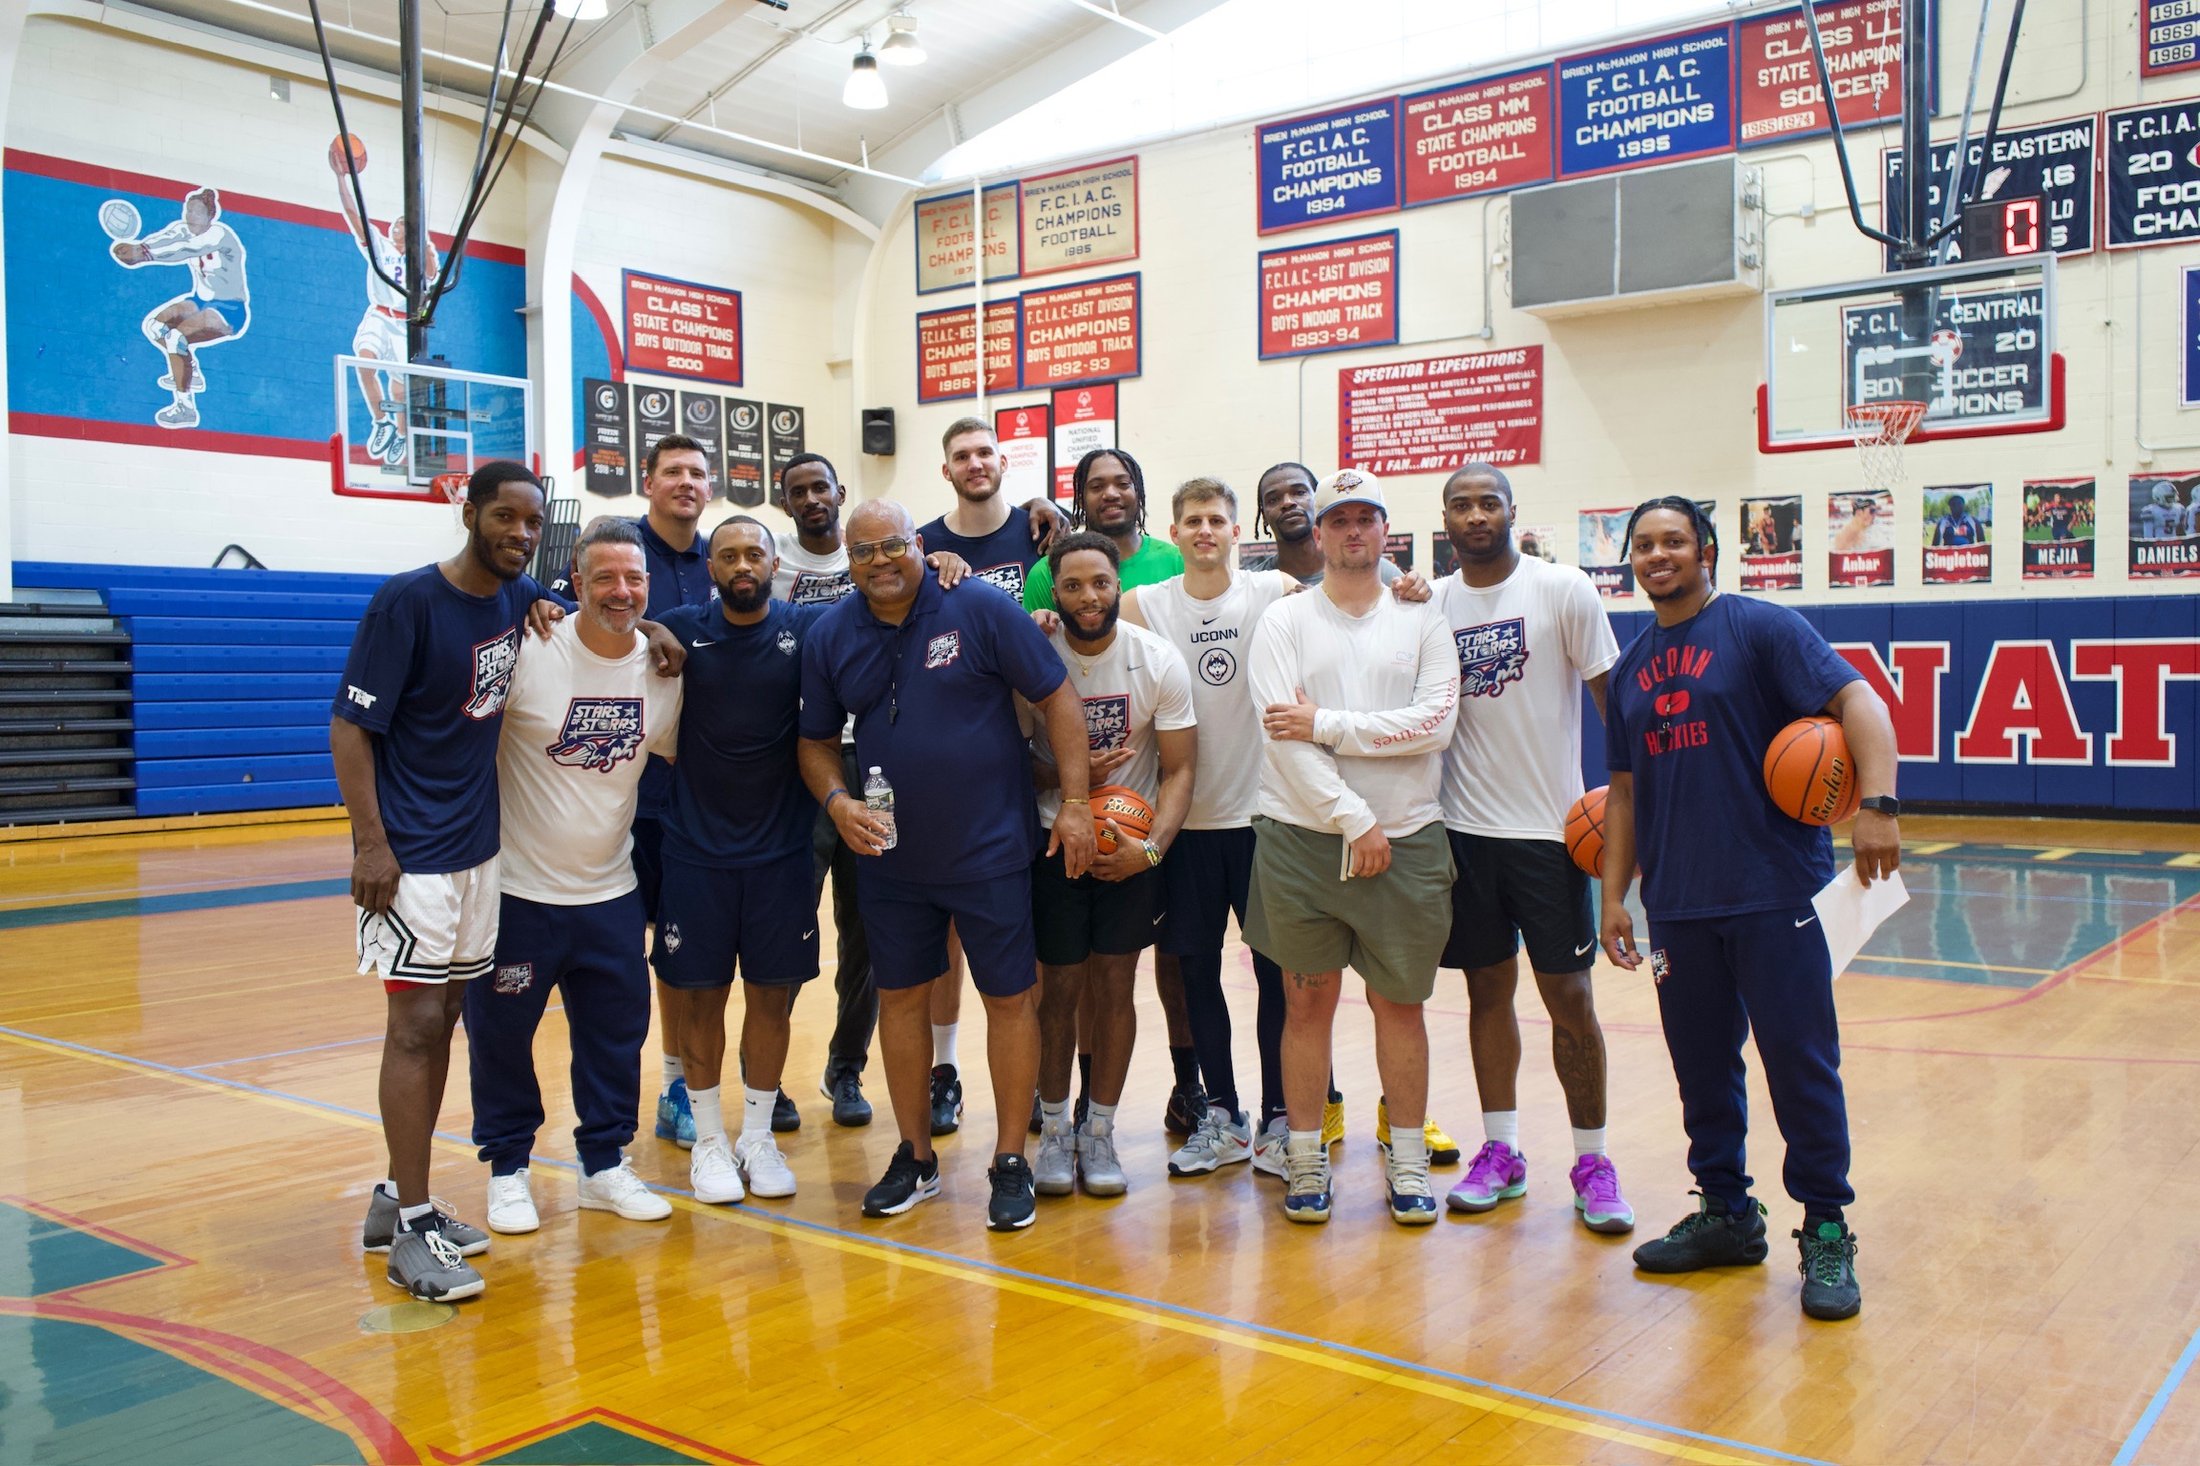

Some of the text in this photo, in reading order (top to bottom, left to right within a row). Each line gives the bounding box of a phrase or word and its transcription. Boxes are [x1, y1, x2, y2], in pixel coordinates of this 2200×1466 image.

[1840, 8, 1861, 20] HIGH
[2154, 1, 2193, 20] 1961
[1765, 26, 1853, 60] CLASS
[2154, 24, 2193, 42] 1969
[1562, 64, 1593, 79] BRIEN
[1652, 45, 1679, 60] HIGH
[1682, 37, 1728, 54] SCHOOL
[1758, 43, 1903, 87] STATE HAMPION
[2153, 45, 2192, 64] 1986
[1483, 85, 1505, 98] HIGH
[1508, 77, 1546, 93] SCHOOL
[1779, 71, 1890, 109] SOCCER
[1587, 82, 1701, 120] FOOTBALL
[1331, 117, 1352, 129] HIGH
[1354, 109, 1390, 124] SCHOOL
[1423, 95, 1530, 132] CLASS MM
[1576, 103, 1715, 146] CHAMPIONS
[1416, 116, 1537, 156] STATE CHAMPIONS
[1618, 134, 1671, 158] 1995
[1282, 149, 1371, 180] FOOTBALL
[1428, 142, 1527, 175] FOOTBALL
[2128, 150, 2173, 175] 20
[1102, 168, 1133, 181] SCHOOL
[1273, 167, 1382, 203] CHAMPIONS
[1455, 168, 1498, 189] 1994
[2042, 163, 2075, 189] 16
[1306, 195, 1346, 215] 1994
[1035, 203, 1121, 231] CHAMPIONS
[2006, 200, 2038, 254] 0
[2133, 208, 2200, 236] CHA
[936, 226, 997, 248] FOOTBLL
[1041, 224, 1116, 247] FOOTBALL
[928, 241, 1007, 268] CHAMPONS
[1358, 241, 1394, 255] SCHOOL
[1349, 256, 1390, 278] DIVISION
[1105, 282, 1135, 294] SCHOOL
[1272, 281, 1382, 310] CHAMPIONS
[647, 296, 702, 318] CLASS
[706, 294, 733, 306] SCHOOL
[1098, 295, 1133, 314] DIVISION
[633, 312, 734, 343] STATE CHAMPIONS
[1271, 303, 1383, 332] BOYS INDOOR TRACK
[1029, 316, 1130, 345] CHAMPIONS
[1291, 326, 1360, 347] 1993-94
[1995, 330, 2036, 353] 20
[634, 332, 733, 360] BOYS OUTDOOR TRACK
[925, 337, 1012, 361] CHAMPONS
[1026, 336, 1133, 363] BOYS OUTDOOR TRACK
[667, 356, 704, 372] 2000
[925, 354, 1012, 379] BOYS INDOO TRACK
[1352, 349, 1526, 383] SPECTATOR EXPECTATIONS
[939, 373, 997, 392] 1986-7
[1863, 377, 1903, 398] BOY
[1373, 460, 1381, 472] A
[1448, 454, 1457, 465] A
[1462, 449, 1516, 464] FANATIC
[1842, 556, 1880, 573] Anbar
[1925, 550, 1989, 572] Singleton
[2037, 547, 2079, 566] MEJIA
[2137, 544, 2199, 566] DANIELS
[1591, 571, 1623, 587] Anbar
[1740, 559, 1803, 577] Hernandez
[799, 575, 842, 587] STARS
[1190, 627, 1239, 644] UCONN
[1457, 628, 1501, 649] STARS
[479, 639, 511, 665] STARS
[1637, 645, 1713, 691] UCONN
[573, 705, 623, 718] STARS
[1810, 757, 1845, 822] Baden
